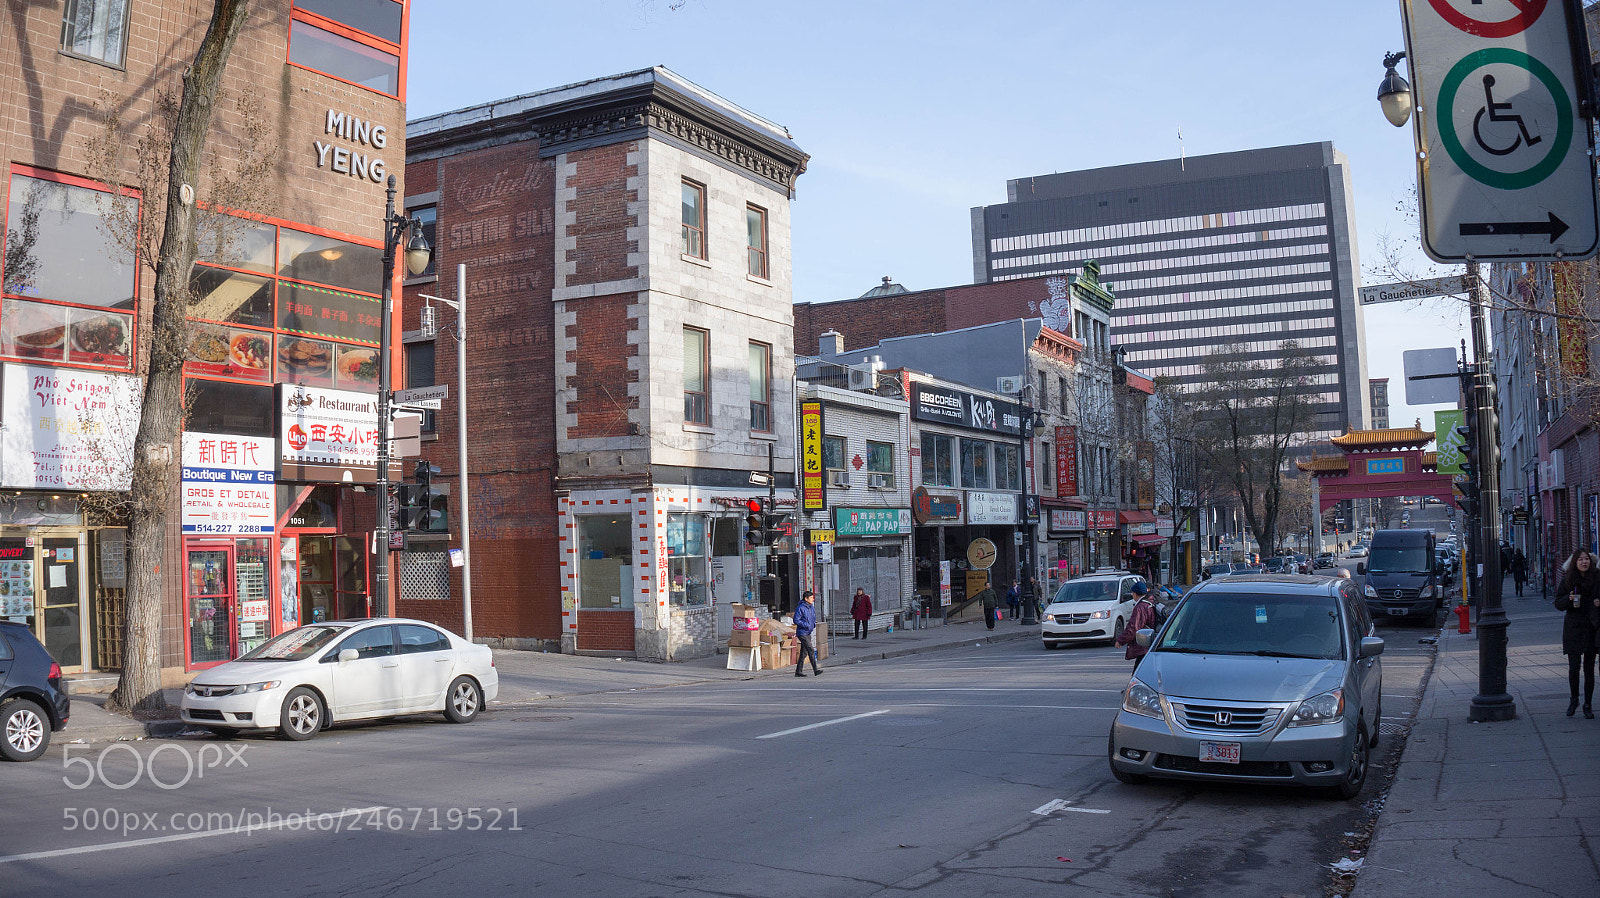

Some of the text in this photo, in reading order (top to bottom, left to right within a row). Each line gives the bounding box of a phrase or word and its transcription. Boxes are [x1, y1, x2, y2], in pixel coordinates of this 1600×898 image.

[326, 108, 387, 149] MING
[314, 140, 386, 182] YENG
[1363, 293, 1375, 302] La
[66, 379, 110, 395] Saigon
[320, 396, 369, 413] Restaurant
[199, 439, 259, 465] 新時代
[806, 428, 818, 470] 老友記
[183, 468, 274, 482] Boutique New Era
[187, 488, 270, 500] GROS ET DETAIL
[187, 500, 213, 508] RETAIL
[228, 501, 270, 509] WHOLESALE
[290, 517, 305, 525] 1051
[865, 521, 881, 532] PAP
[884, 521, 898, 532] PAP
[197, 525, 260, 533] 514-227 2288
[0, 548, 24, 557] OUVERT
